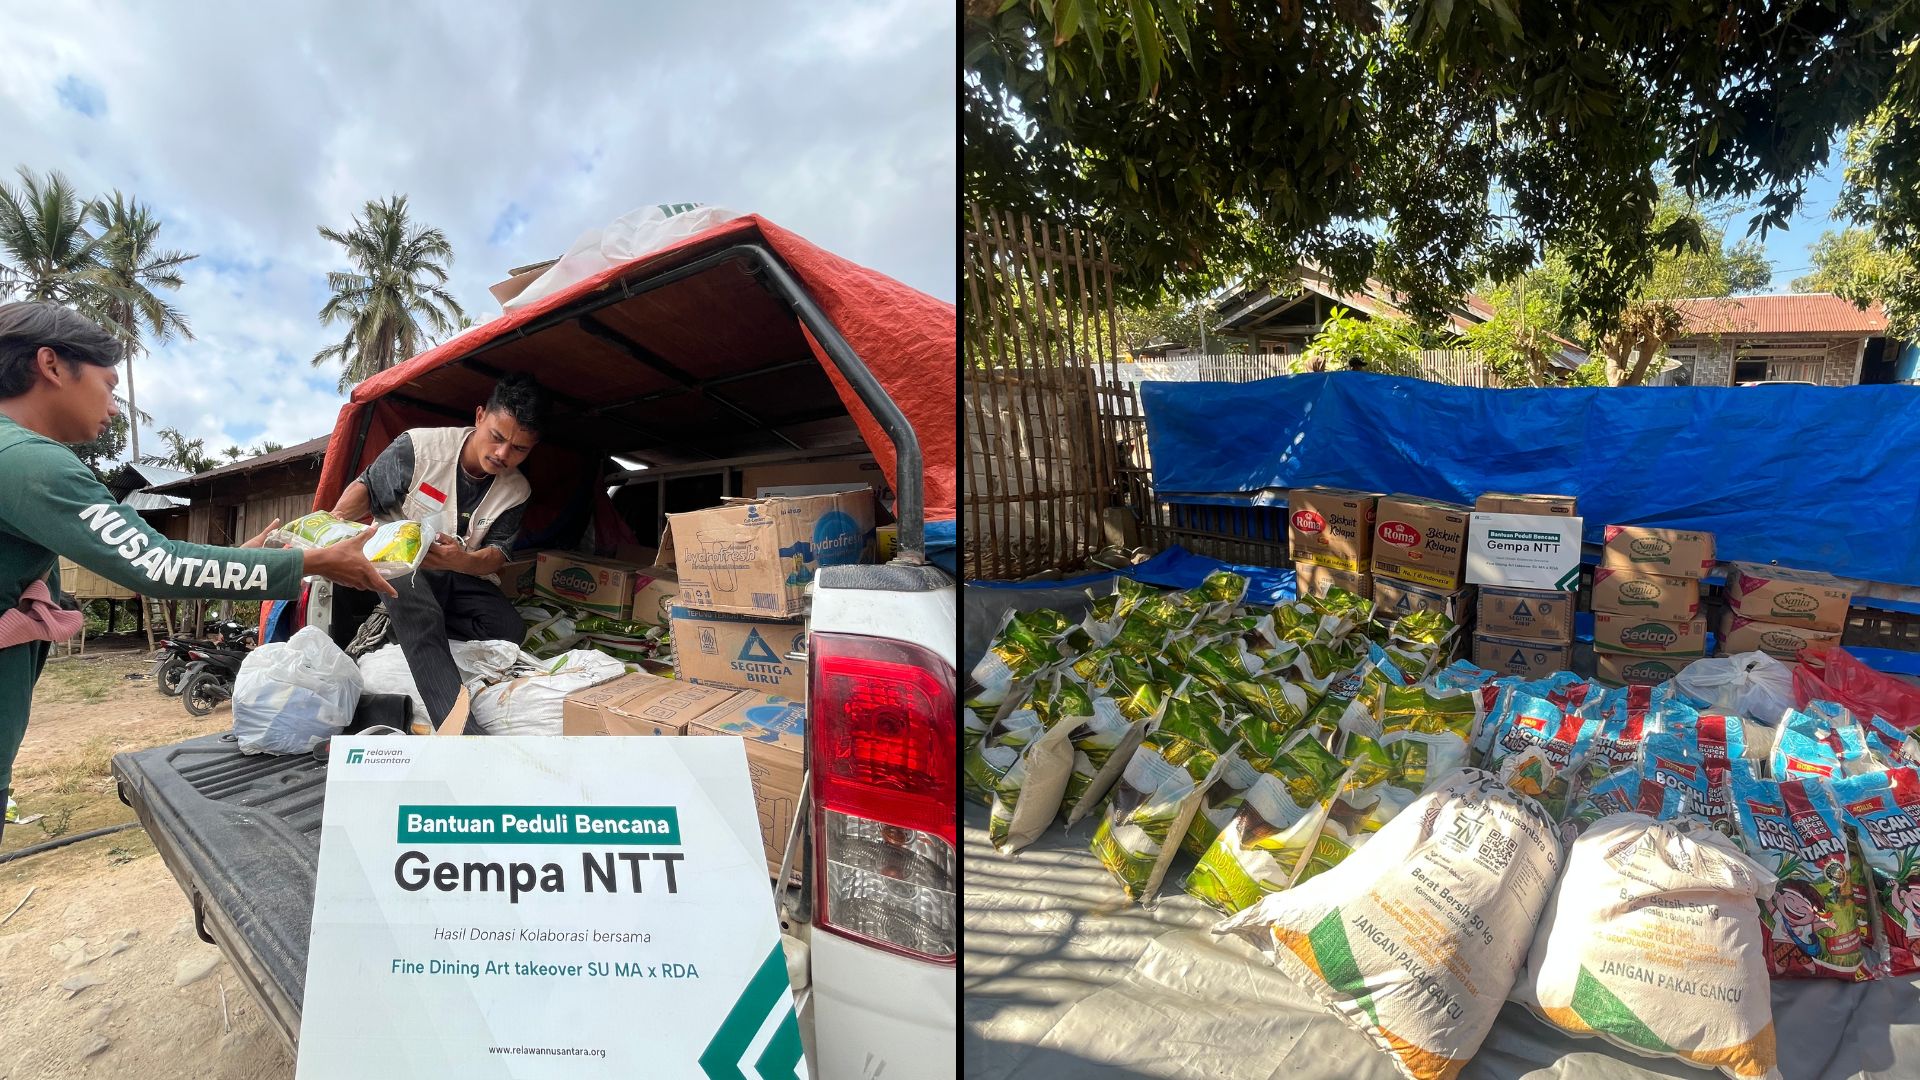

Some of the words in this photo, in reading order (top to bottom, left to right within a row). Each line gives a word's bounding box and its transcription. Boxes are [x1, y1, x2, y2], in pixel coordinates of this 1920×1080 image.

[1296, 516, 1321, 530] Roma
[1329, 513, 1357, 528] Biskuit
[1330, 524, 1355, 539] Kelapa
[1383, 527, 1415, 543] Roma
[1426, 527, 1461, 544] Biskuit
[78, 503, 268, 591] NUSANTARA
[684, 544, 756, 564] hydrofresh
[1425, 539, 1457, 555] Kelapa
[1487, 540, 1530, 553] Gempa
[1533, 543, 1561, 554] NTT
[1637, 541, 1664, 553] Sania
[552, 571, 597, 595] Sedaap
[1626, 584, 1653, 596] Sania
[1621, 628, 1677, 647] Sedaap
[731, 661, 793, 676] SEGITIGA
[746, 672, 780, 685] BIRU
[1656, 771, 1707, 804] BOCAH
[407, 813, 495, 833] Bantuan
[501, 814, 568, 834] Peduli
[575, 814, 670, 834] Bencana
[1793, 814, 1820, 828] BERAS
[1798, 821, 1824, 835] SUPER
[1499, 810, 1546, 852] Nusantara
[1802, 827, 1827, 841] POLES
[1115, 854, 1137, 879] MAS
[394, 850, 565, 904] Gempa
[582, 852, 685, 894] NTT
[1411, 867, 1441, 893] Berat
[1439, 887, 1471, 918] Bersih
[1469, 914, 1484, 931] 50
[1481, 926, 1494, 945] kg
[1651, 894, 1685, 912] Bersih
[1688, 902, 1704, 914] 50
[1707, 903, 1719, 921] kg
[1446, 911, 1460, 927] Gula
[433, 927, 467, 941] Hasil
[469, 928, 516, 941] Donasi
[519, 928, 589, 942] Kolaborasi
[593, 929, 651, 943] bersama
[391, 958, 425, 974] Fine
[430, 959, 480, 978] Dining
[485, 960, 510, 975] Art
[515, 960, 583, 976] takeover
[588, 961, 610, 977] SU
[615, 962, 643, 978] MA
[648, 966, 657, 978] x
[662, 963, 699, 979] RDA
[1351, 914, 1400, 956] JANGAN
[1395, 951, 1431, 988] PAKAI
[1426, 981, 1464, 1020] GANCU
[1600, 959, 1654, 984] JANGAN
[1657, 973, 1696, 996] PAKAI
[1700, 983, 1743, 1003] GANCU
[488, 1045, 606, 1058] www.relawannusantara.org
